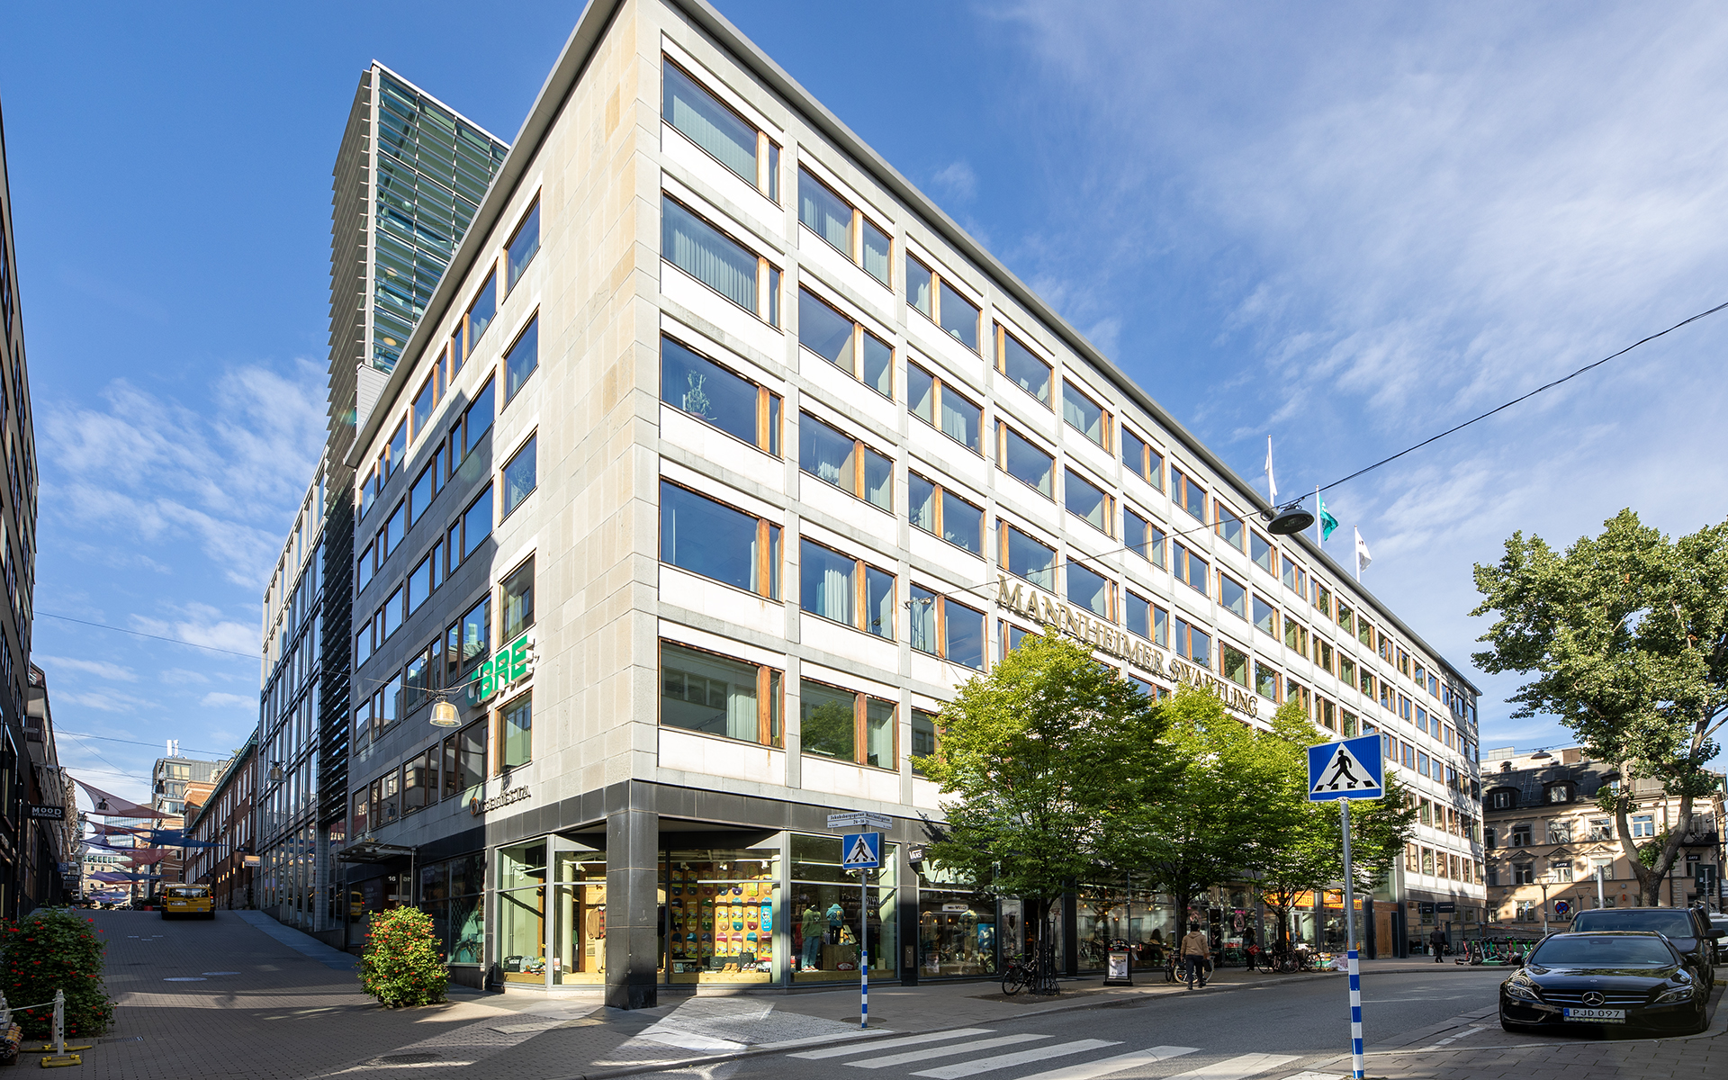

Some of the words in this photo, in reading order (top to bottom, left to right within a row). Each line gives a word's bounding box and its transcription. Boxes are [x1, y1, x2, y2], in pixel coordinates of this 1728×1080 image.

[996, 574, 1166, 675] MANNHEIMER
[465, 634, 533, 707] CBRE
[32, 806, 62, 815] MOOD
[1212, 887, 1230, 902] JUCE
[1573, 1009, 1594, 1017] PJD
[1598, 1010, 1620, 1018] 097
